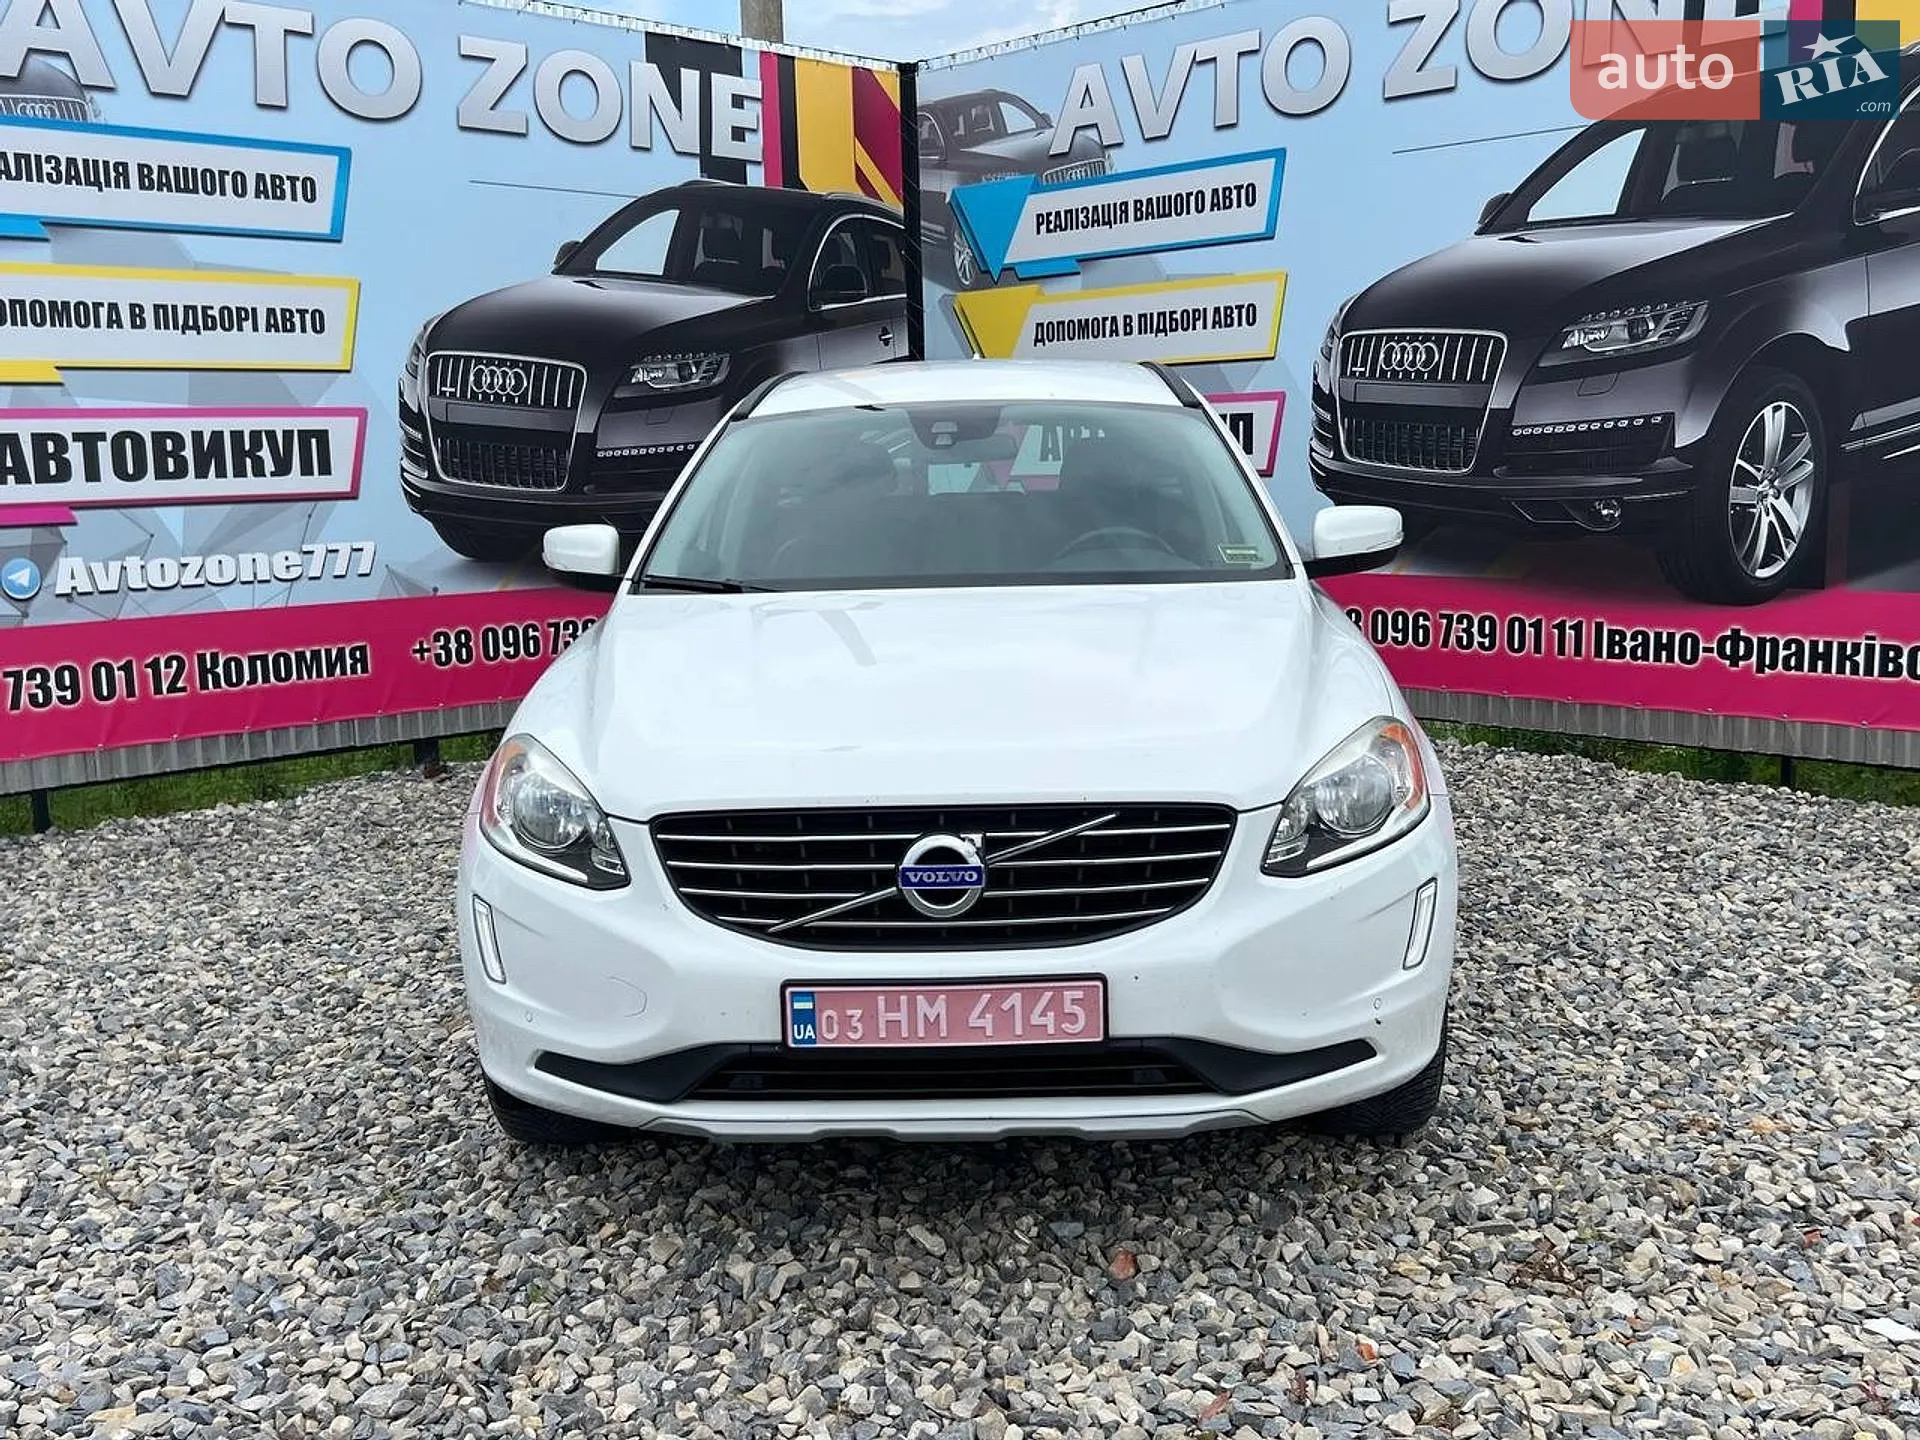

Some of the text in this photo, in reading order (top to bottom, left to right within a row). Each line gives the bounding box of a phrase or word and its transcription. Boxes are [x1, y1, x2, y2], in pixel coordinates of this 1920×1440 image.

[0, 0, 764, 163] AVTO ZONE
[1048, 15, 1352, 157] AVTO
[136, 162, 248, 199] ВАШОГО
[254, 172, 317, 204] АВТО
[1035, 182, 1257, 236] РЕАЛІЗАЦІЯ ВАШОГО АВТО
[128, 302, 147, 330] В
[152, 303, 259, 336] ПІДБОРІ
[265, 307, 326, 335] АВТО
[1033, 302, 1257, 348] ДОПОМОГА В ПІДБОРІ АВТО
[0, 428, 333, 486] АВТОВИКУП
[55, 541, 376, 595] Avtozone777
[412, 629, 474, 667] +38
[481, 623, 541, 663] 096
[1371, 608, 1431, 648] 096
[1438, 612, 1497, 652] 739
[1506, 616, 1543, 655] 01
[1551, 619, 1584, 658] 11
[2, 646, 369, 711] 739 01 12 Коломия
[905, 871, 978, 883] VOLVO
[793, 1024, 816, 1040] UA
[821, 990, 1086, 1040] 03 HM 4145
